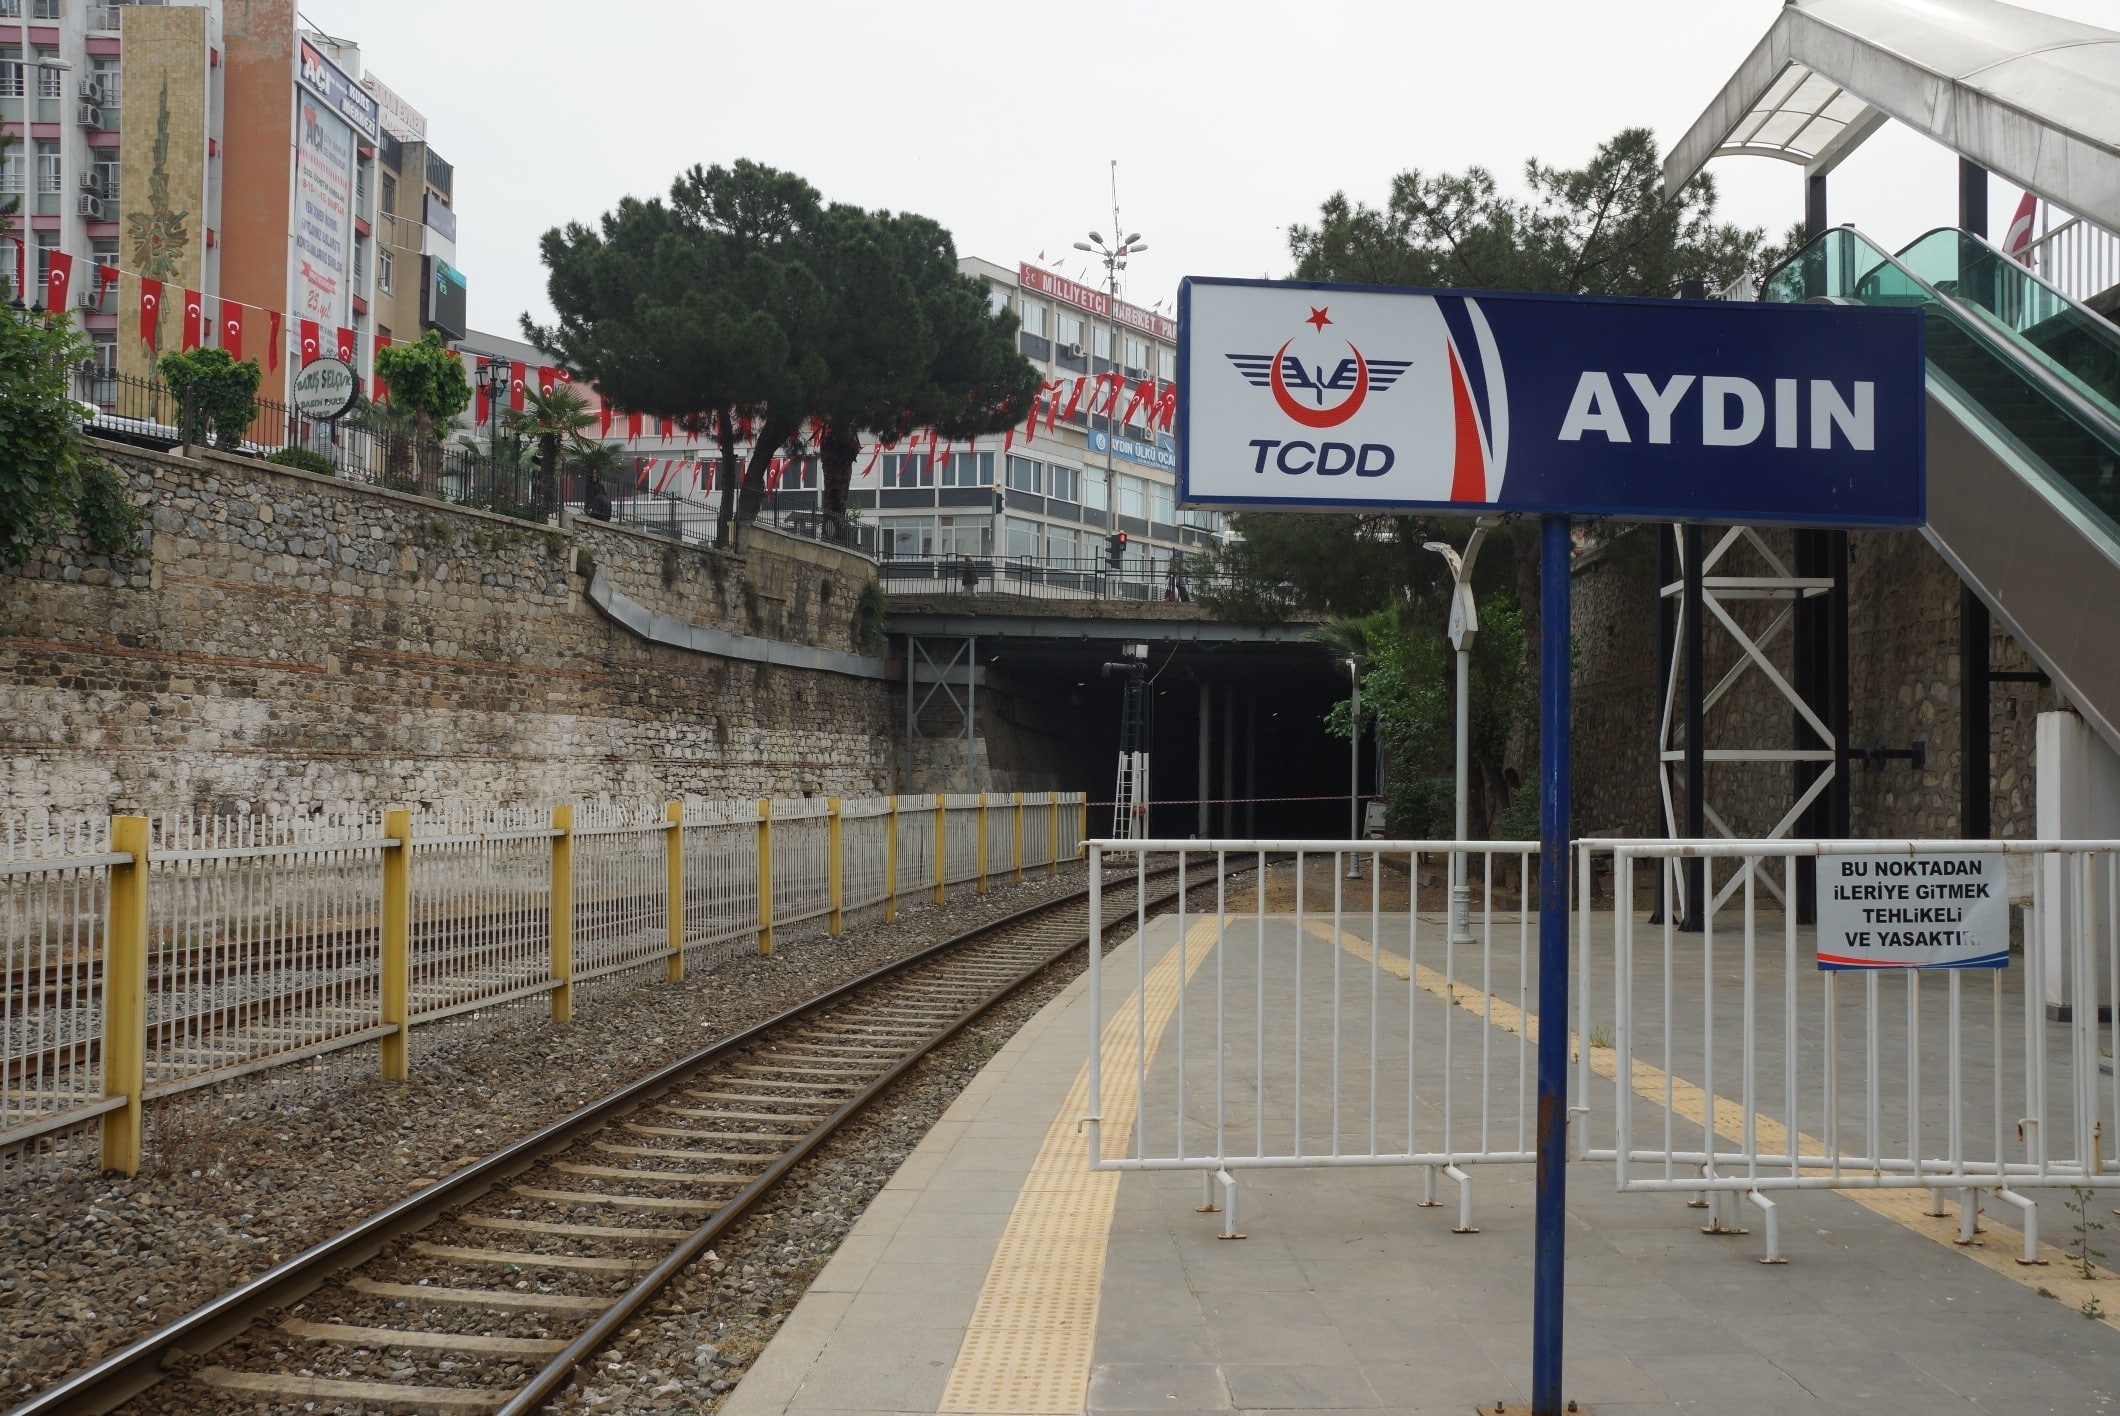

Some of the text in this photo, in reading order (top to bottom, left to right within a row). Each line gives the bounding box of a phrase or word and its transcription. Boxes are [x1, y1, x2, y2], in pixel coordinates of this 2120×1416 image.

[349, 83, 370, 112] KURS
[1042, 274, 1106, 313] MİLLİYETÇİ
[1112, 300, 1156, 331] HAREKET
[1558, 370, 1875, 451] AYDIN
[1111, 438, 1133, 456] AYDIN
[1135, 442, 1156, 461] ÜLKÜ
[1158, 451, 1176, 467] OCA
[1248, 439, 1395, 478] TCDD
[1841, 860, 1982, 877] BU NOKTADAN
[1845, 932, 1870, 947] VE
